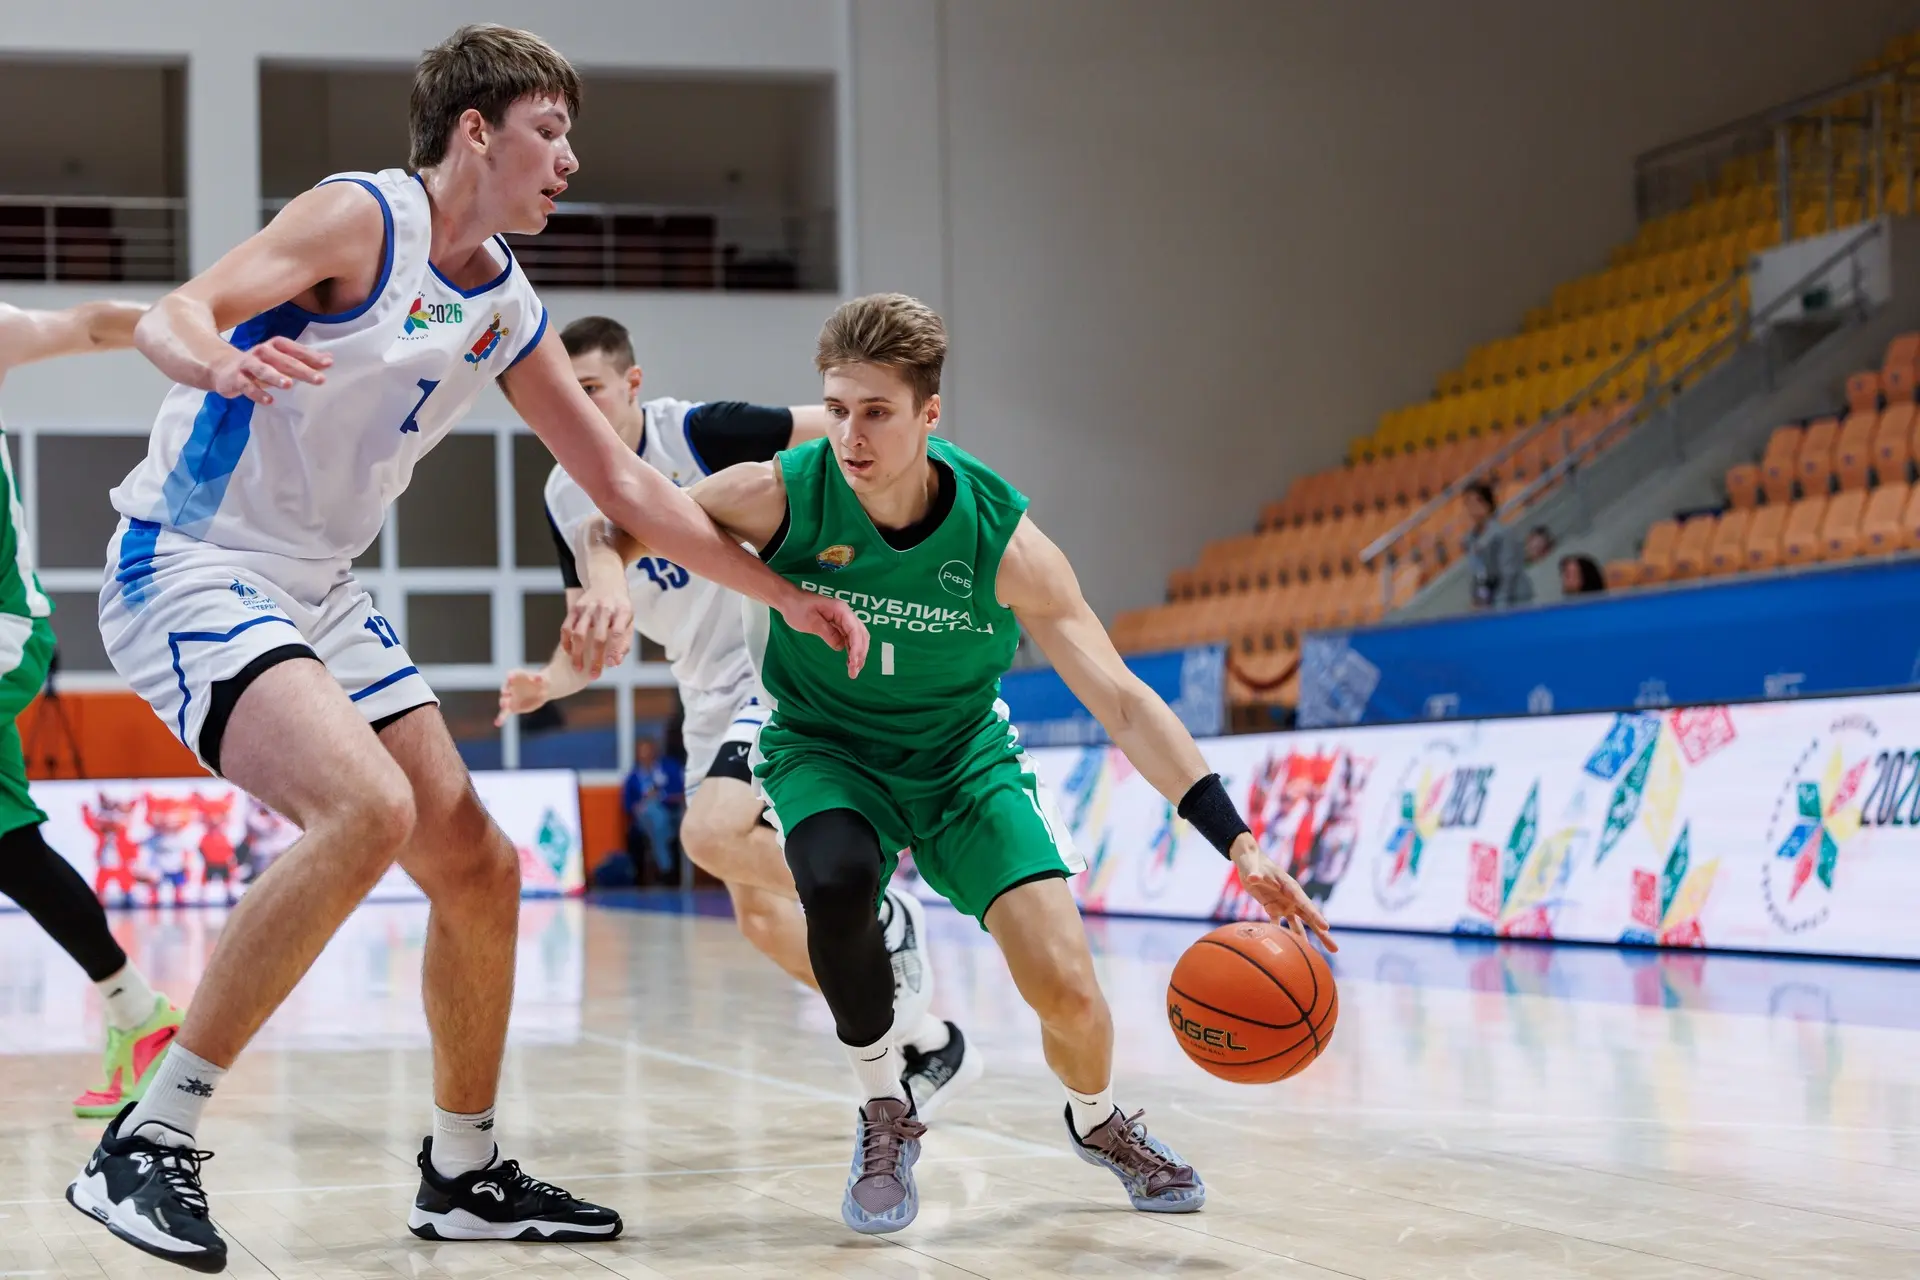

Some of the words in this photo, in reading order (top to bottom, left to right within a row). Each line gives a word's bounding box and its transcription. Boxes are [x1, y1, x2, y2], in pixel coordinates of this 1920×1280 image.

[427, 303, 463, 324] 2026
[943, 571, 973, 589] РФБ
[801, 580, 973, 627] РЕСПУБЛИКА
[881, 641, 895, 676] 1
